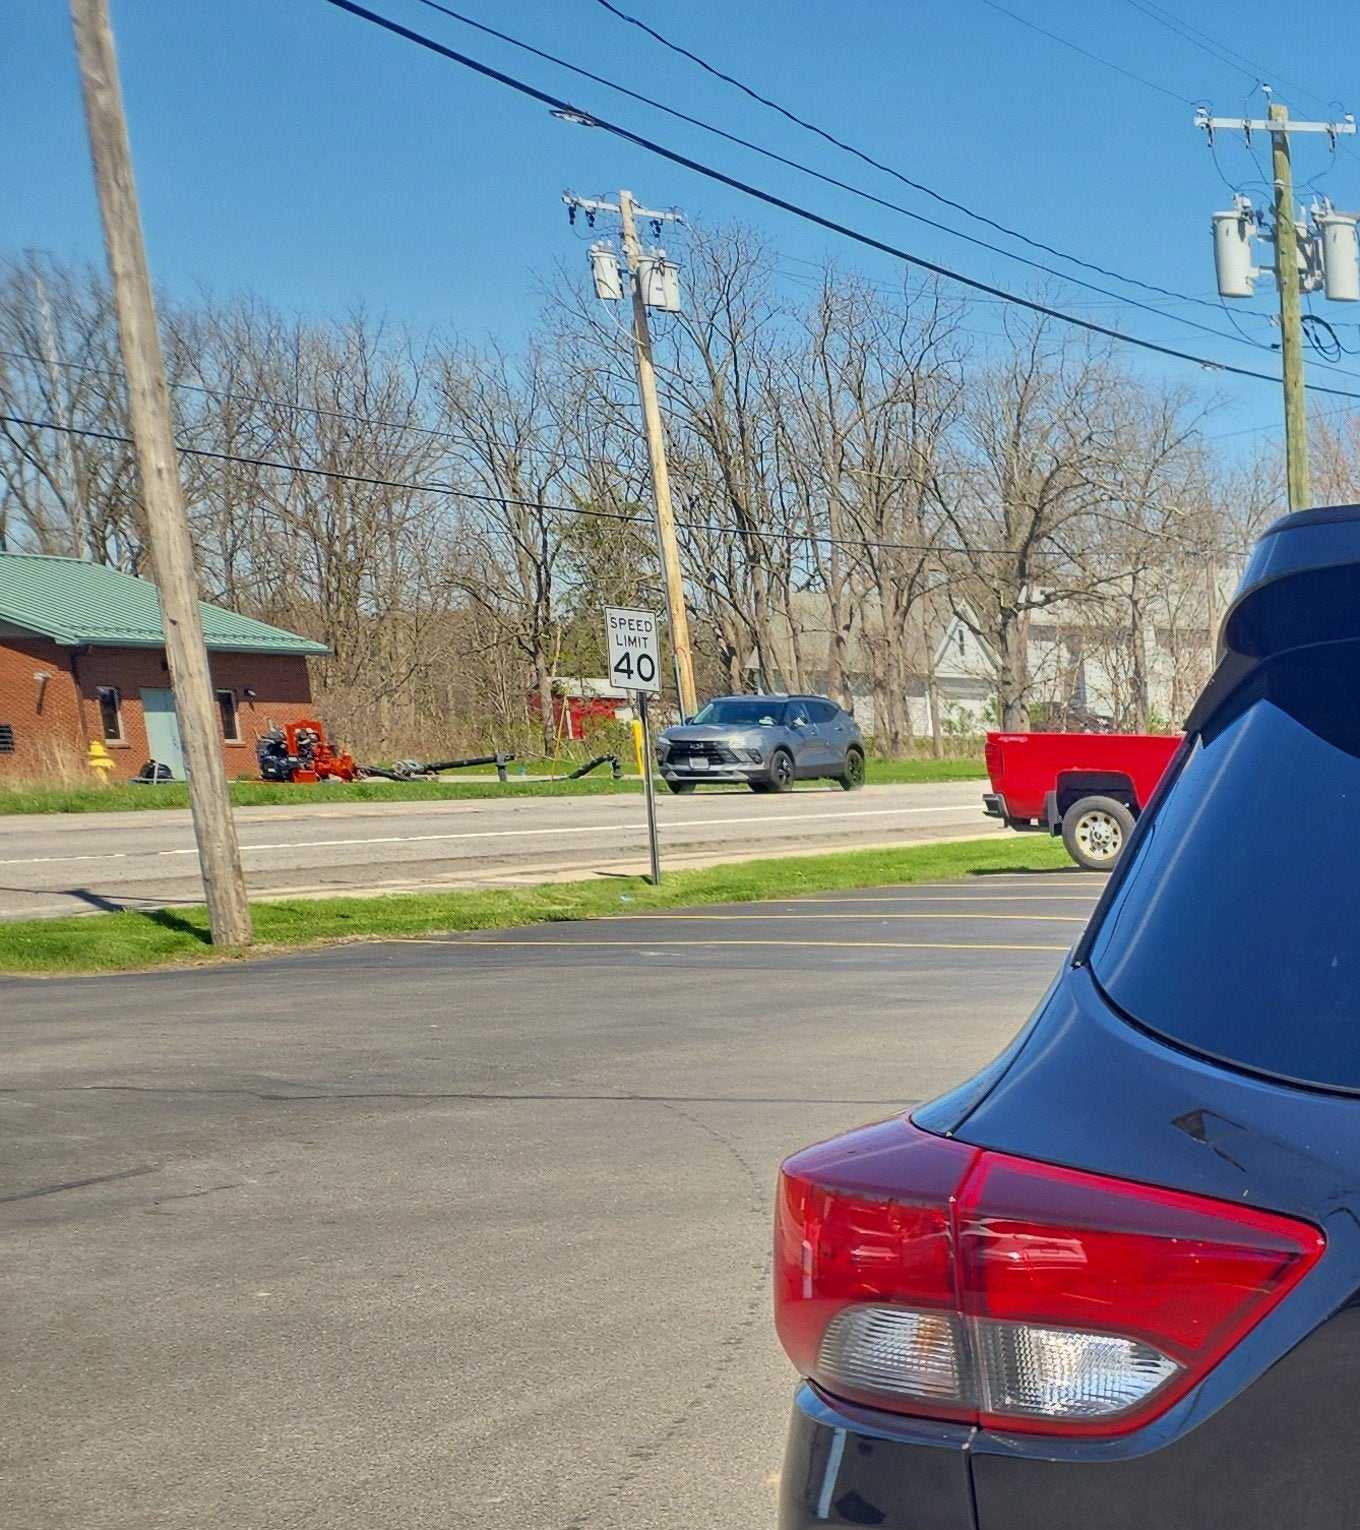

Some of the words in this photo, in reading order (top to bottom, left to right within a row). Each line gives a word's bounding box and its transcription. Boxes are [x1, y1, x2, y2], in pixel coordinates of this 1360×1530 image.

[610, 616, 653, 632] SPEED
[615, 633, 649, 649] LIMIT
[613, 651, 656, 682] 40
